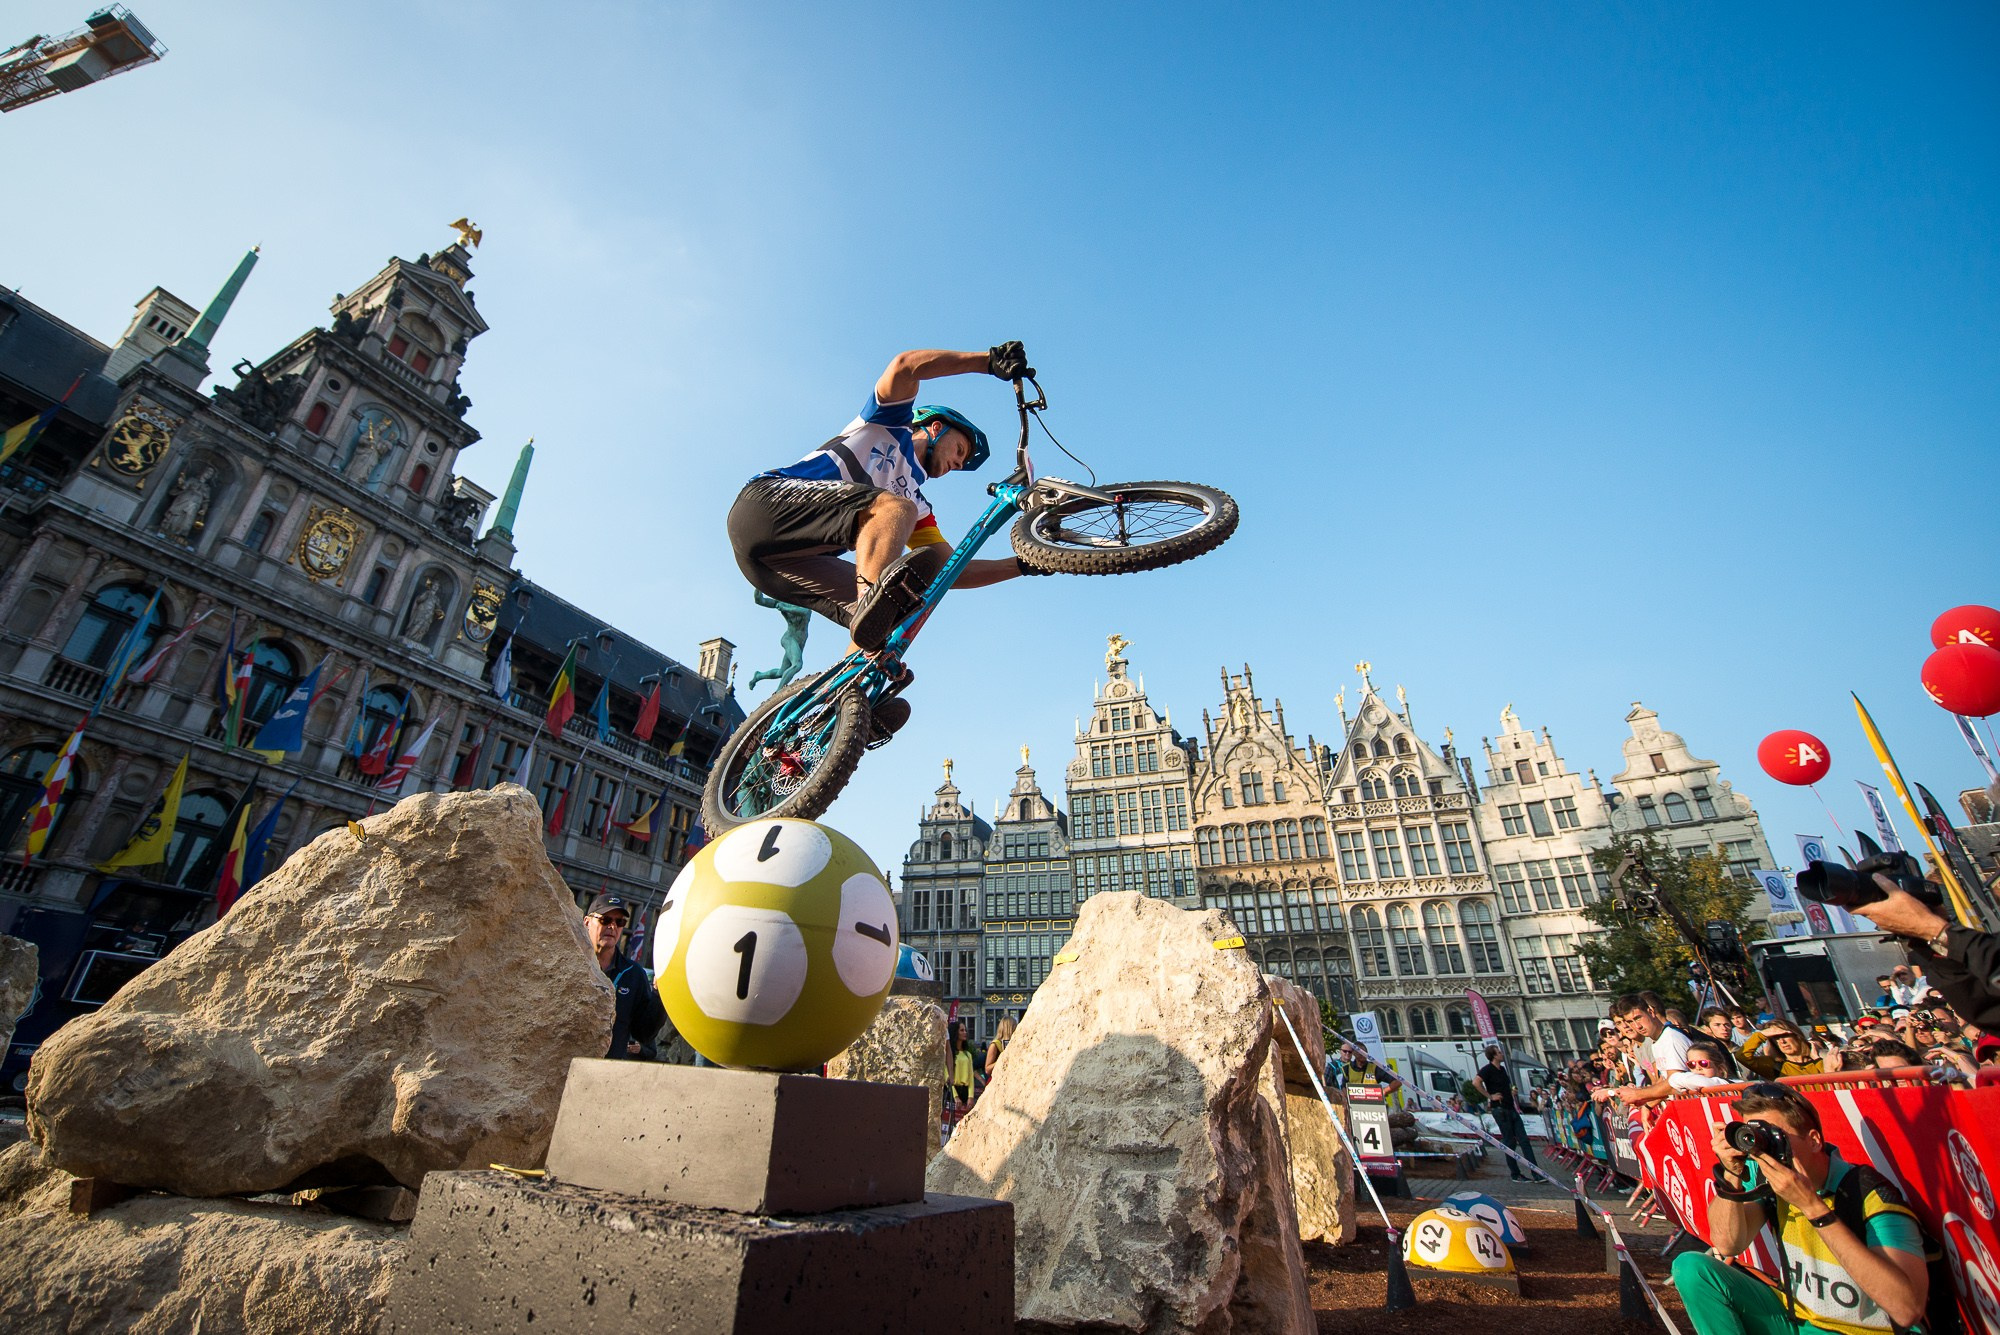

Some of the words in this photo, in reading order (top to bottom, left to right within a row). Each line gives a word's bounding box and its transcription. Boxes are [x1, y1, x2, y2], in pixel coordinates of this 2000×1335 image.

[757, 825, 782, 862] 1
[855, 921, 891, 947] 1
[734, 931, 757, 1000] 1
[1352, 1111, 1386, 1122] FINISH
[1363, 1127, 1380, 1150] 4
[1420, 1224, 1444, 1253] 42
[1476, 1233, 1503, 1259] 42
[1789, 1261, 1860, 1308] HOTO
